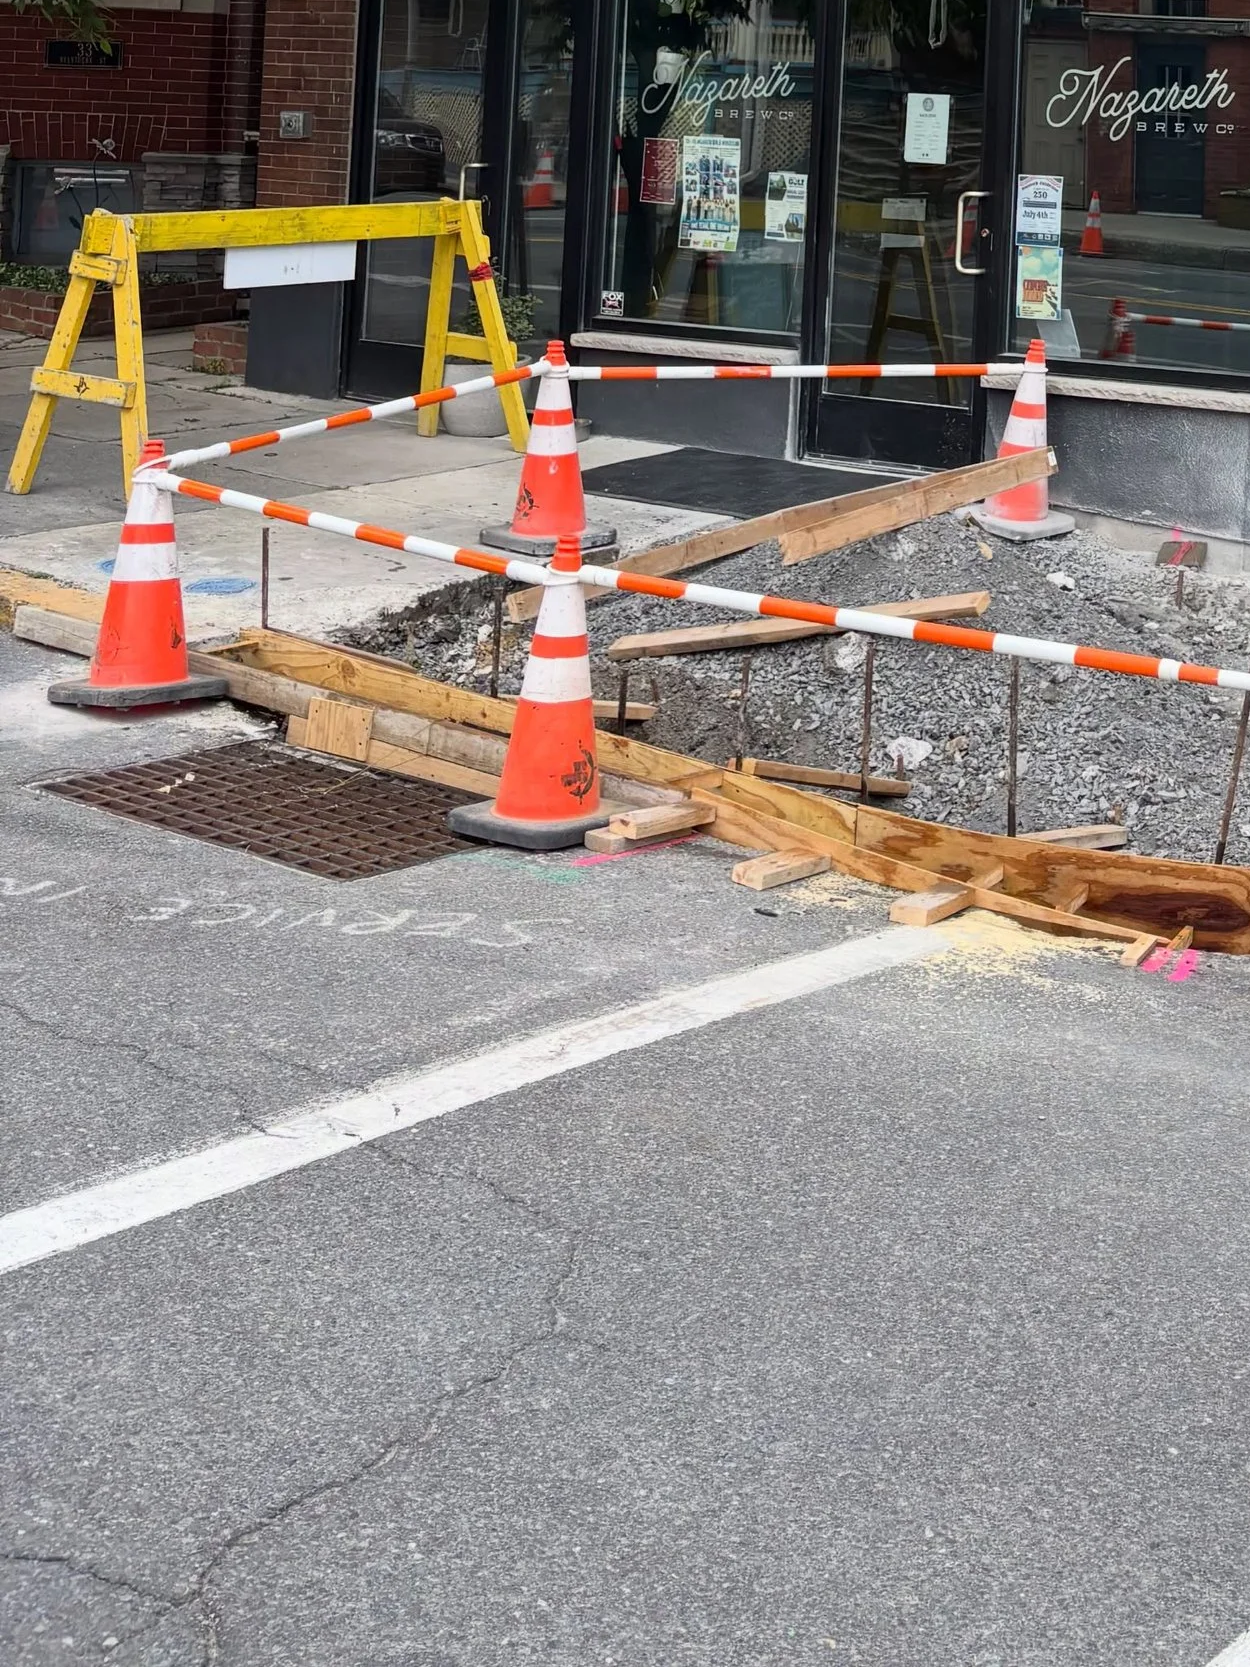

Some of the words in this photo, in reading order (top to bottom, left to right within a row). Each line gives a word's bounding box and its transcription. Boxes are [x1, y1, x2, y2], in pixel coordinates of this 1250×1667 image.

[77, 43, 93, 58] 33
[641, 49, 796, 127] Nazareth
[1045, 55, 1237, 142] Nazareth
[714, 109, 774, 120] BREW
[1136, 121, 1209, 134] BREW
[1033, 191, 1048, 199] 250
[1022, 210, 1036, 220] July
[1037, 211, 1049, 220] 4th
[602, 293, 622, 301] FOX
[127, 896, 573, 949] SERVICE
